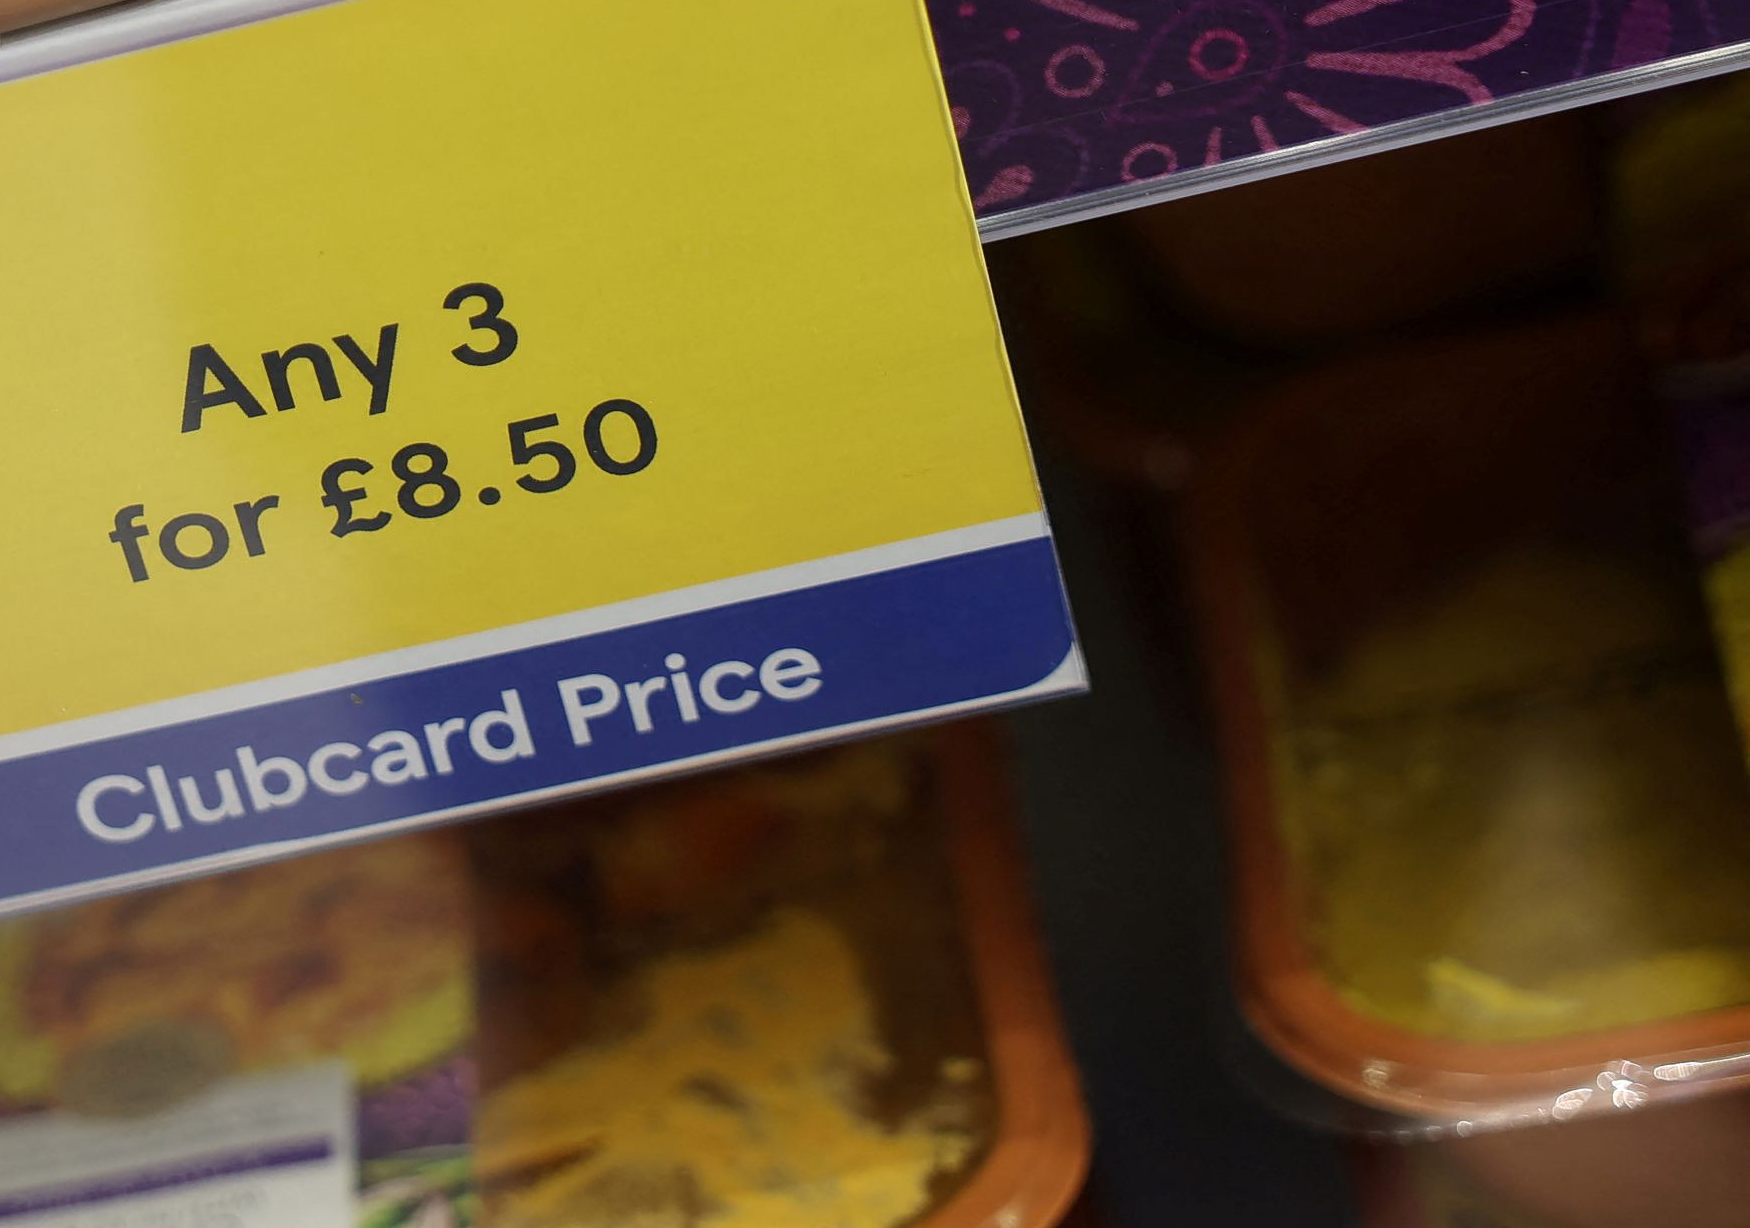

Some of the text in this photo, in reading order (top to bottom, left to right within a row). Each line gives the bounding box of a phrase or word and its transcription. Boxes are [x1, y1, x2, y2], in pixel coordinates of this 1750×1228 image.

[181, 282, 519, 433] Any 3
[109, 398, 658, 583] for £8.50
[75, 645, 824, 844] Clubcard Price
